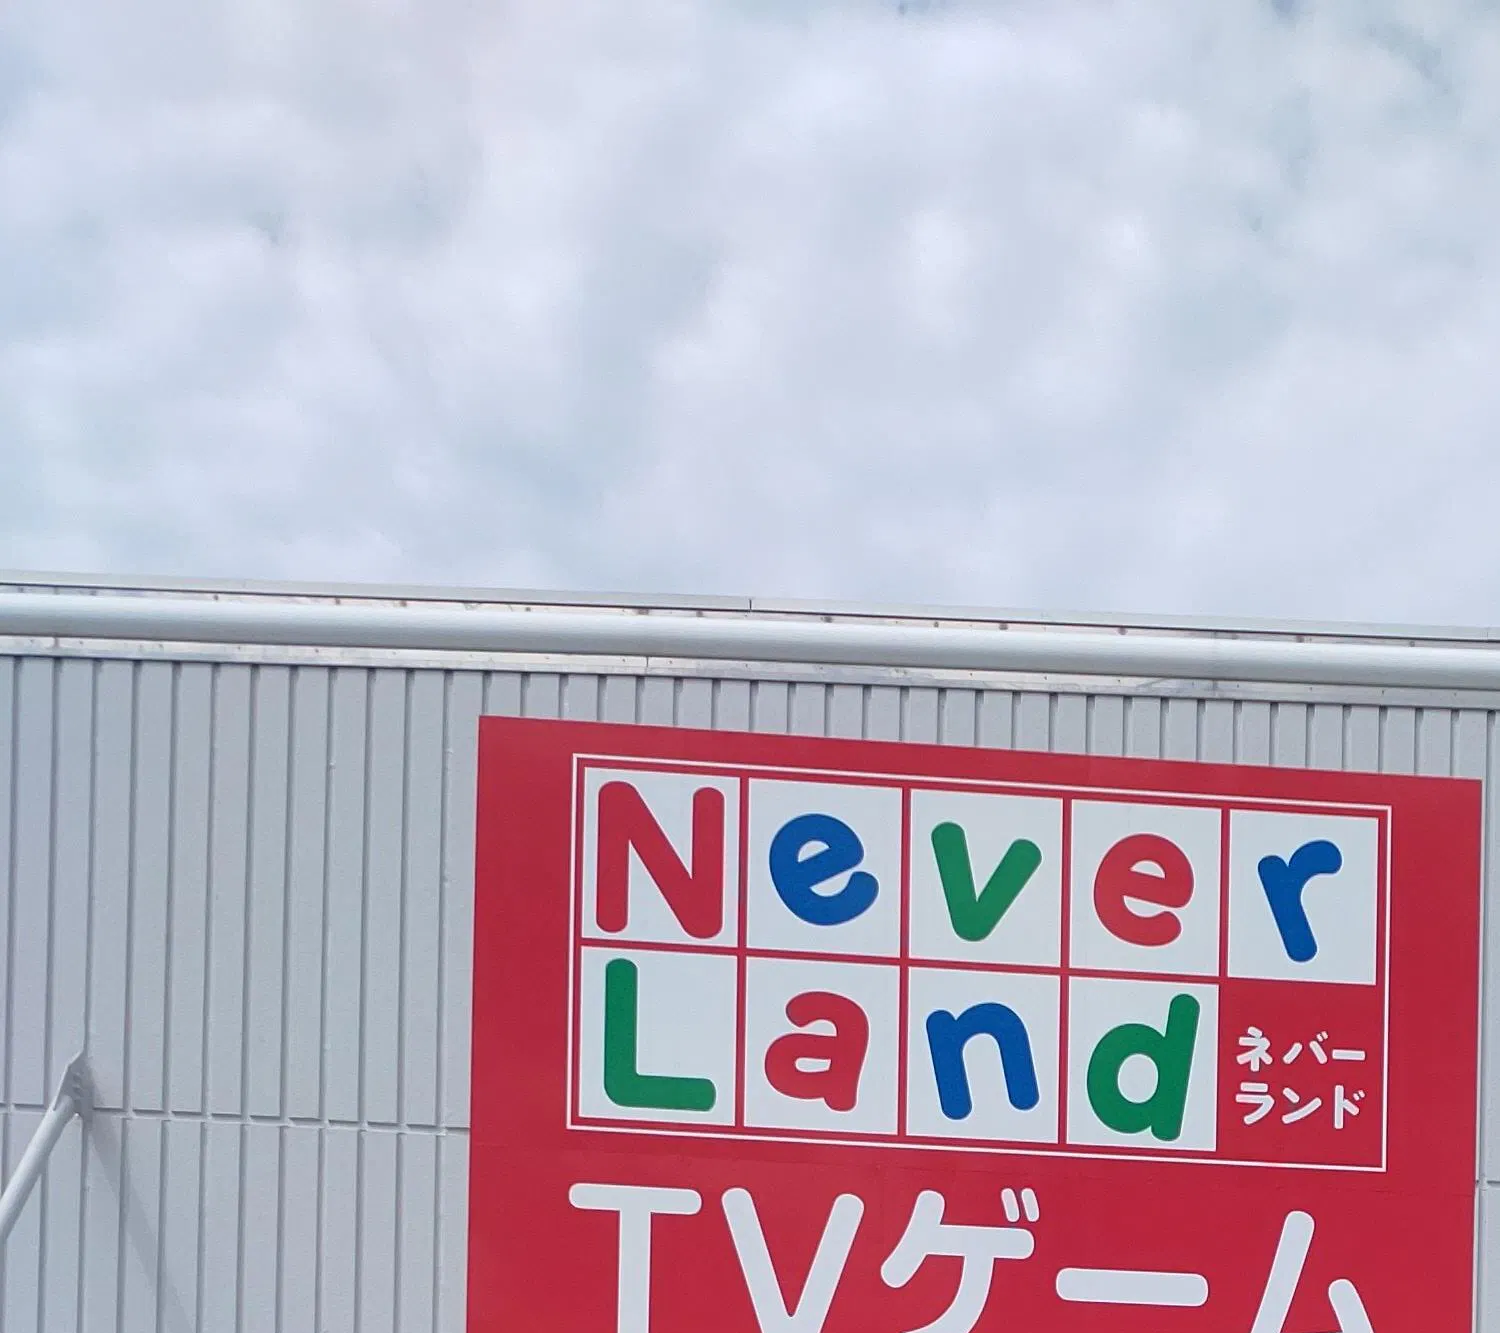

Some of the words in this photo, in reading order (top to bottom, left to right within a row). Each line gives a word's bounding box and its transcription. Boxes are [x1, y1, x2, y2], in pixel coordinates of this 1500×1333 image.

[597, 780, 1343, 963] Never
[603, 958, 1201, 1142] Land
[1236, 1026, 1367, 1072] ネバー
[1236, 1080, 1367, 1130] ランド
